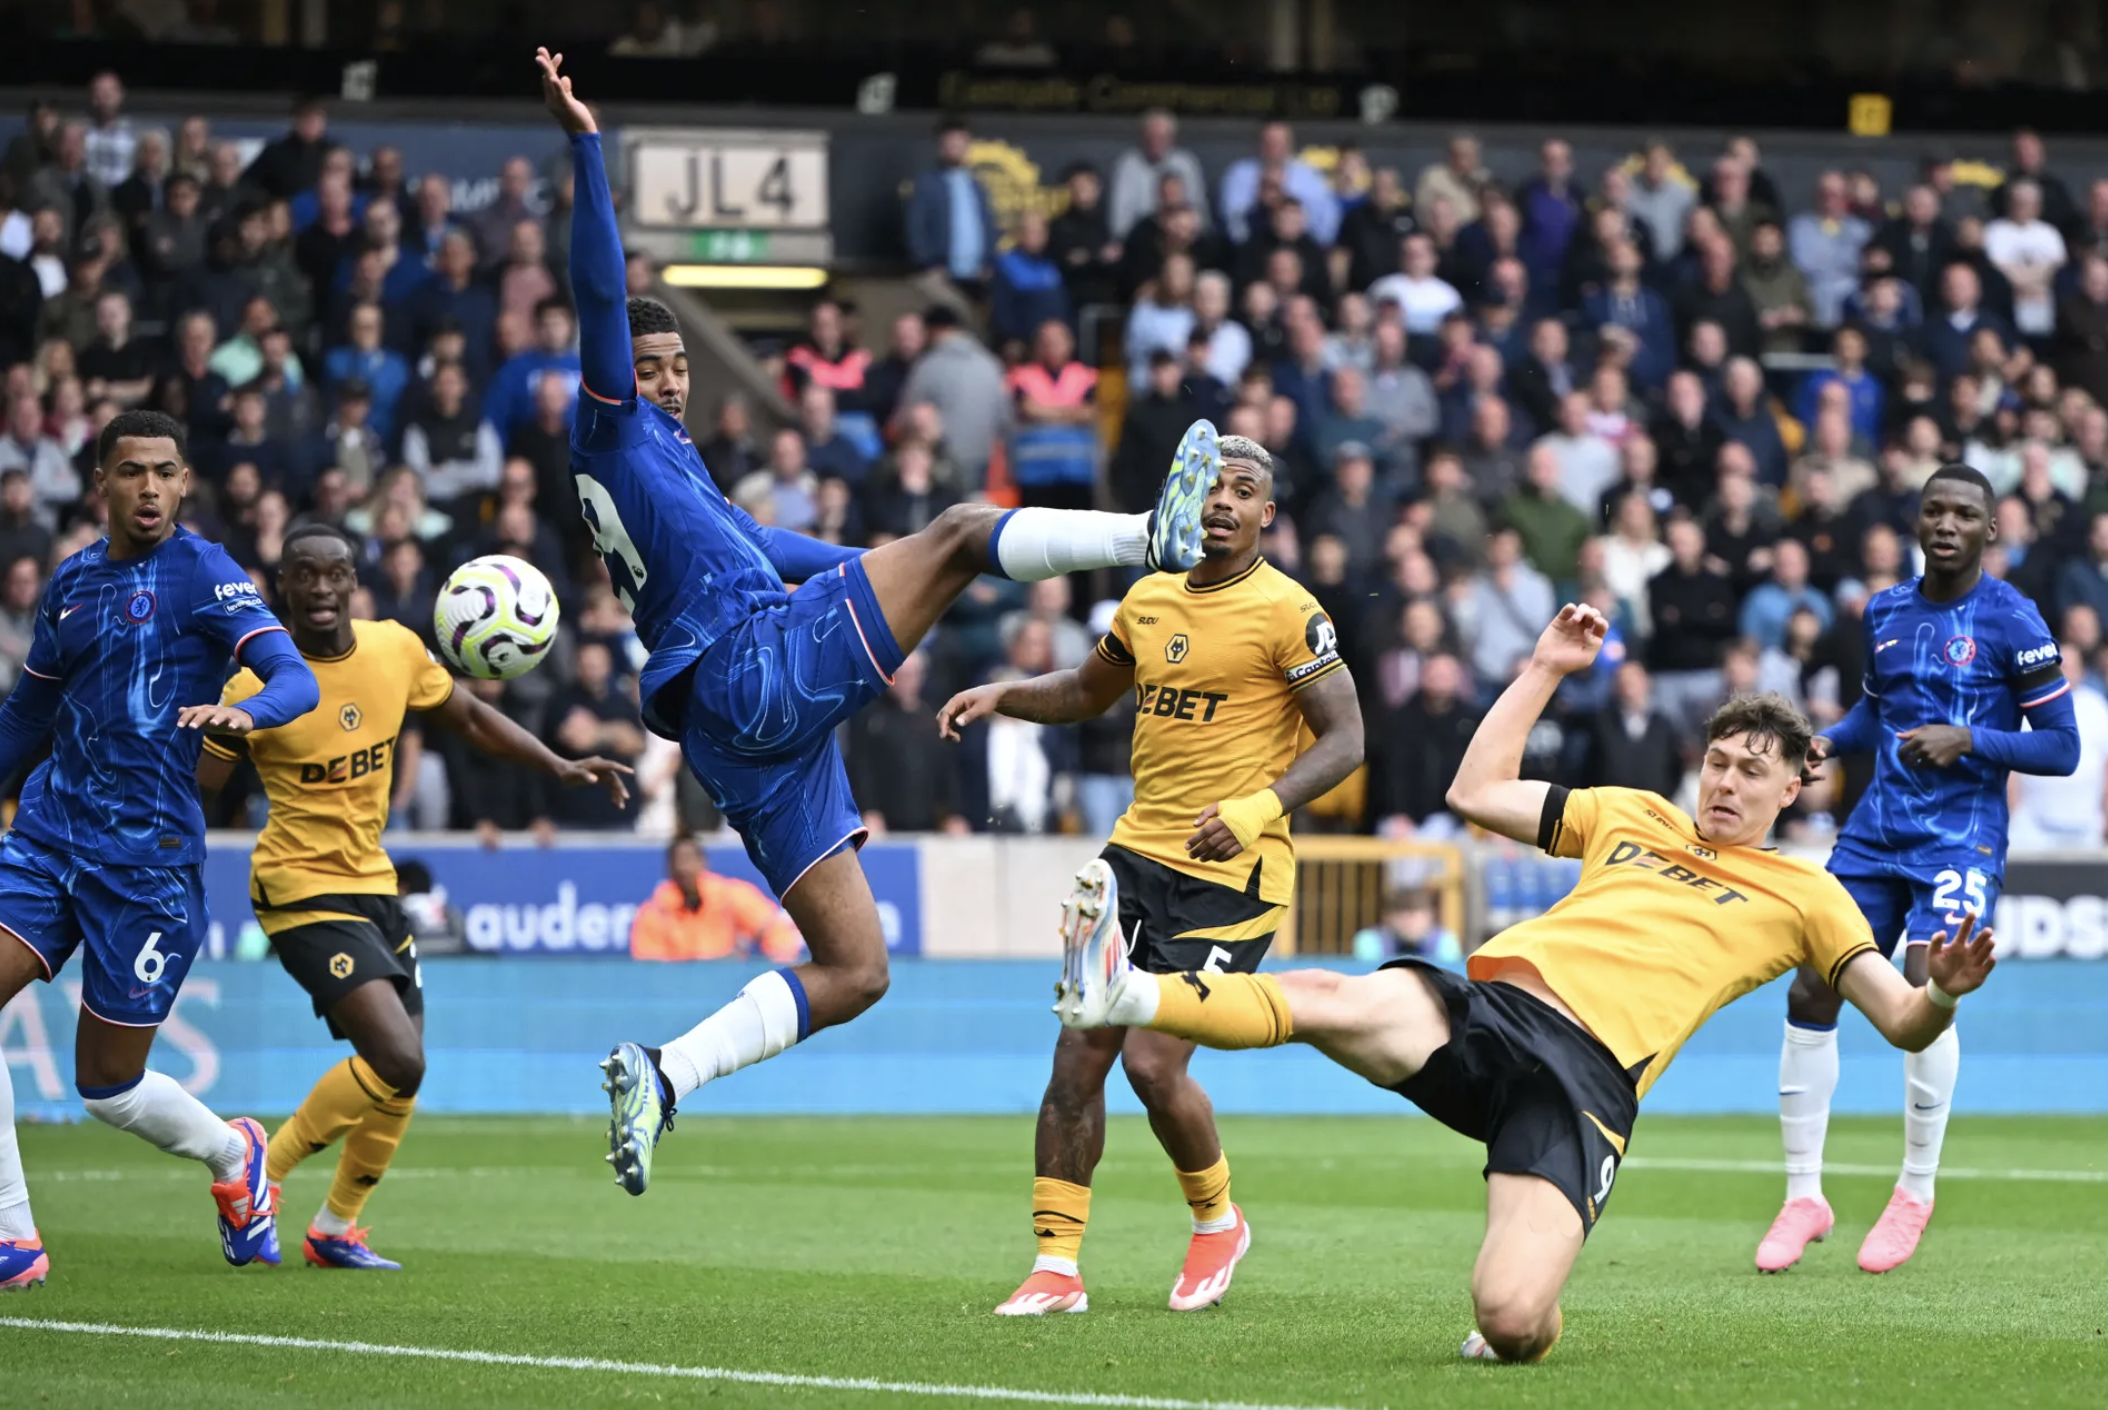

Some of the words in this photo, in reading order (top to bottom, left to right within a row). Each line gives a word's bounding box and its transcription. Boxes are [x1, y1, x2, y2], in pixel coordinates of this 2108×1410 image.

[1604, 841, 1749, 905] DEBET
[1932, 869, 1987, 918] 25
[134, 932, 165, 983] 6
[1594, 1155, 1615, 1204] 9
